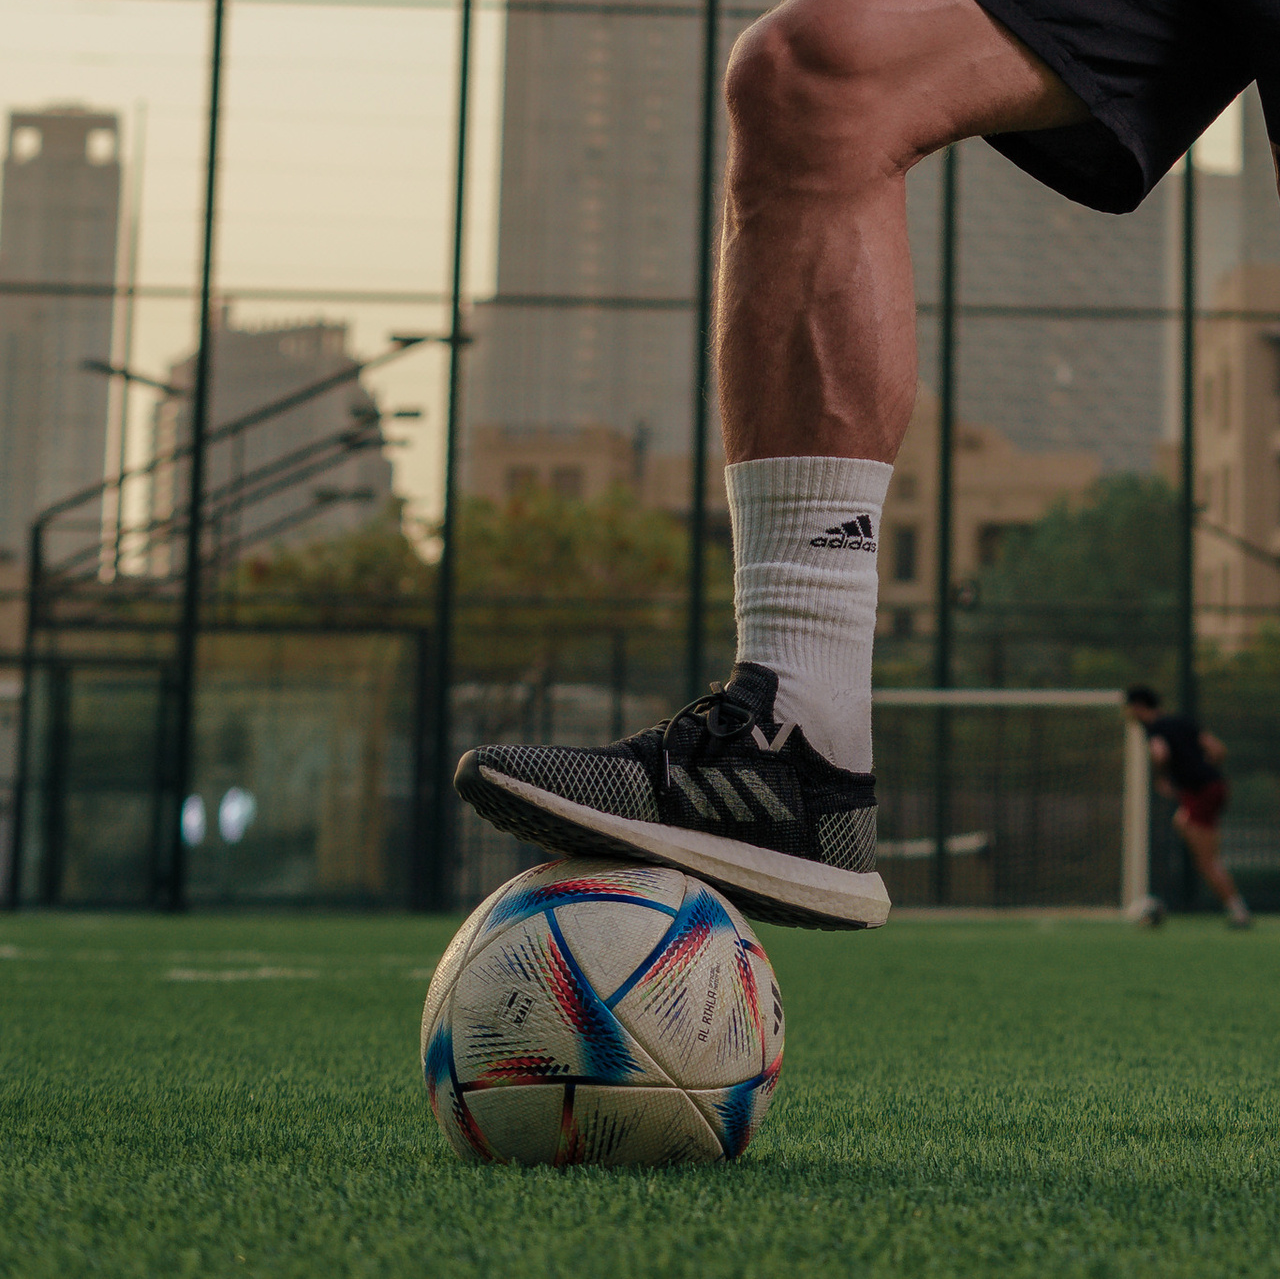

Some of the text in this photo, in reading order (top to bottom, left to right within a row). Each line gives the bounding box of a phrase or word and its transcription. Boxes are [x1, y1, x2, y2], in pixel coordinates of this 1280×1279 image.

[809, 534, 877, 553] adidas
[513, 997, 532, 1022] FIFA
[697, 990, 716, 1042] AL RIHLA
